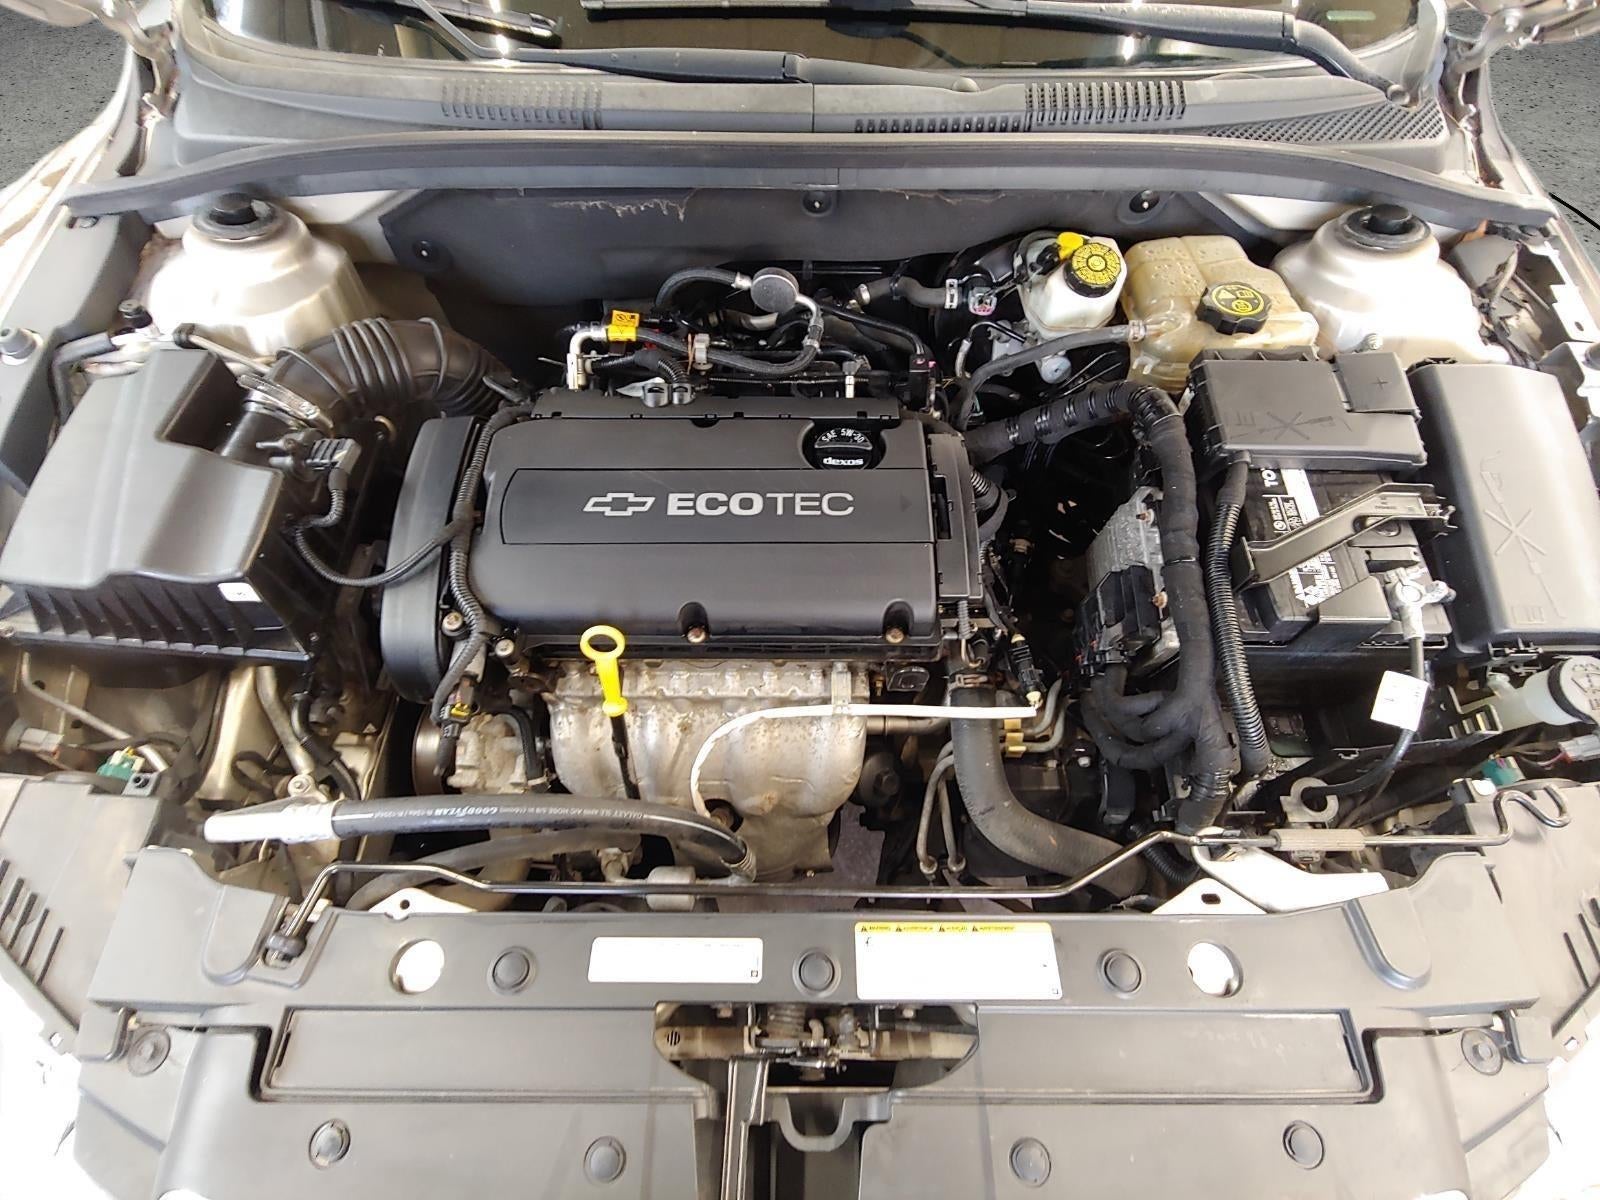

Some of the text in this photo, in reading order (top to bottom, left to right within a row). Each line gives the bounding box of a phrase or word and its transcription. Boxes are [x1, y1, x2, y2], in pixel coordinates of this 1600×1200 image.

[821, 428, 865, 443] SAE 5W-30
[822, 456, 864, 466] dexos
[1261, 468, 1277, 487] TO
[666, 492, 855, 517] ECOTEC
[434, 805, 498, 818] GOODYEAR
